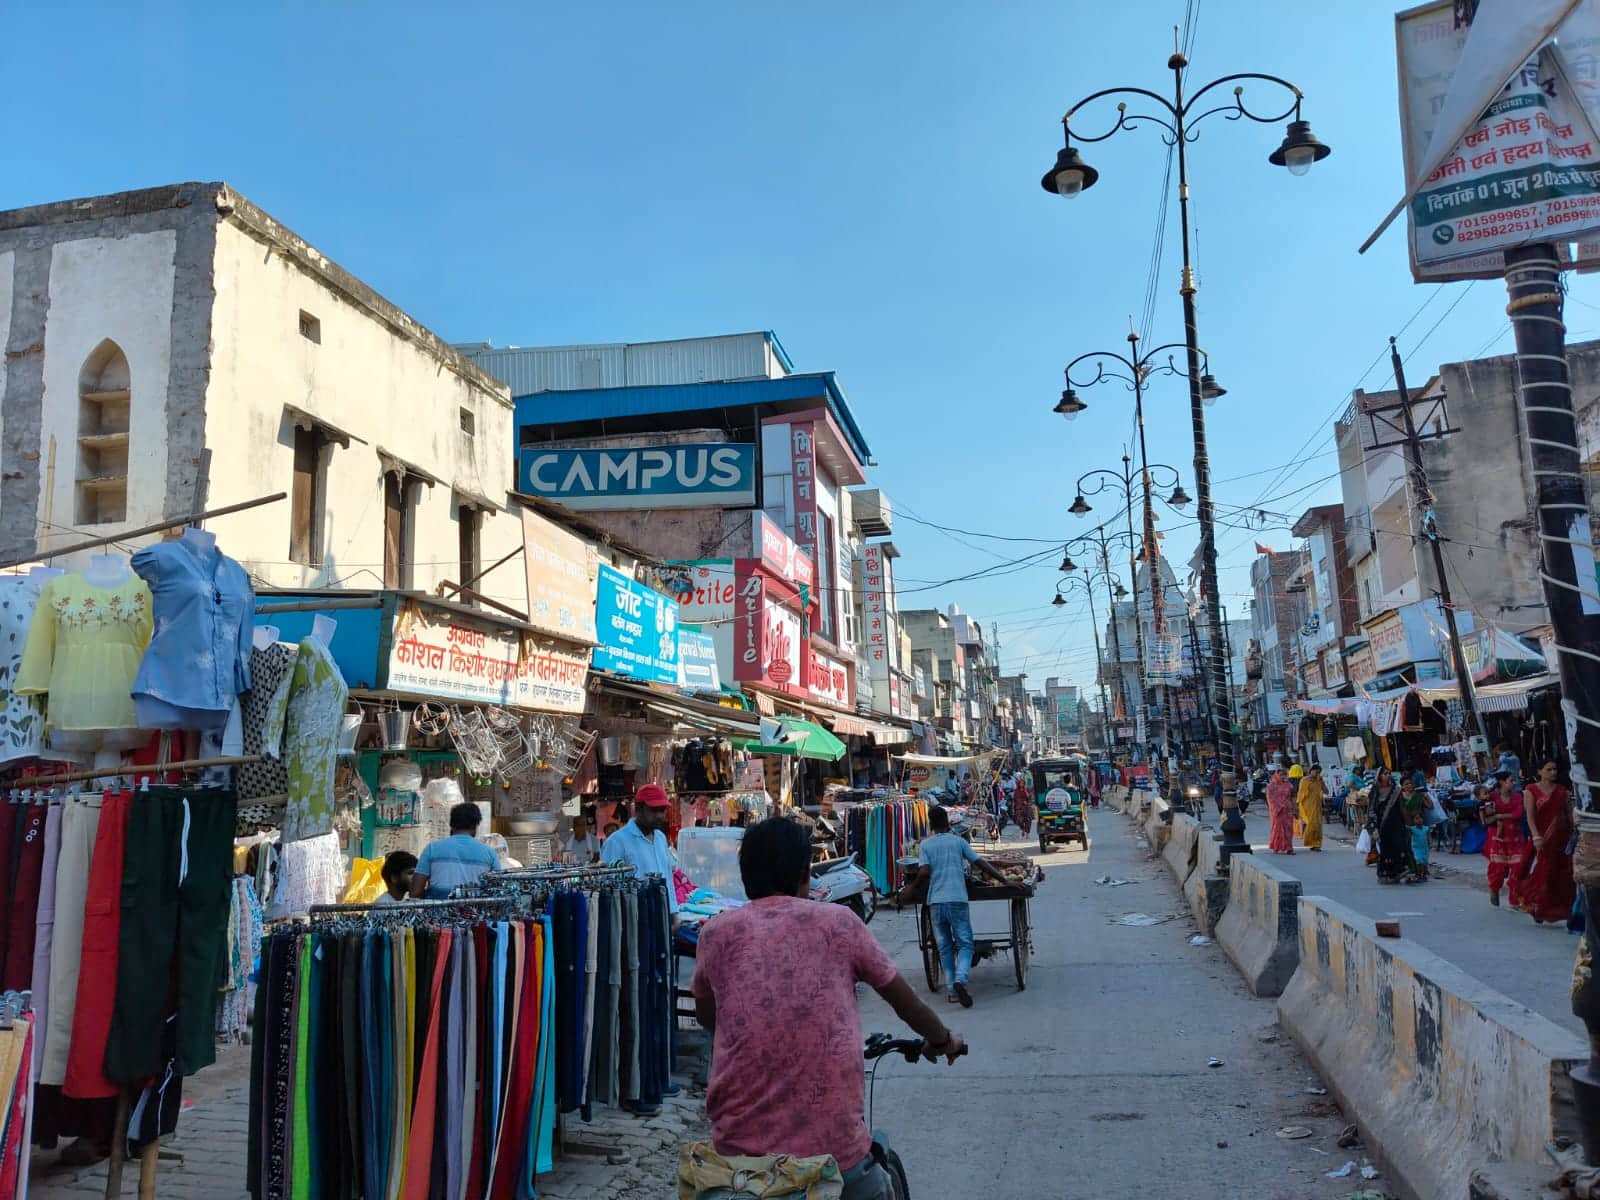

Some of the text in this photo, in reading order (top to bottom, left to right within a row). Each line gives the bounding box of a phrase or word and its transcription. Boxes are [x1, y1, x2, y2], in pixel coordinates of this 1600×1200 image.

[1464, 125, 1490, 148] एवं
[1495, 116, 1531, 137] जोड़
[1471, 148, 1498, 170] एवं
[1427, 186, 1475, 214] दिनांक
[1477, 182, 1499, 200] 01
[1501, 176, 1529, 199] जून
[1532, 170, 1570, 190] 2025
[529, 448, 742, 492] CAMPUS
[446, 624, 485, 649] अग्रवाल
[737, 576, 762, 663] Brite
[397, 634, 446, 671] कौशल
[449, 645, 488, 678] किशोर
[537, 650, 559, 682] बर्तन
[559, 660, 587, 688] भण्डार
